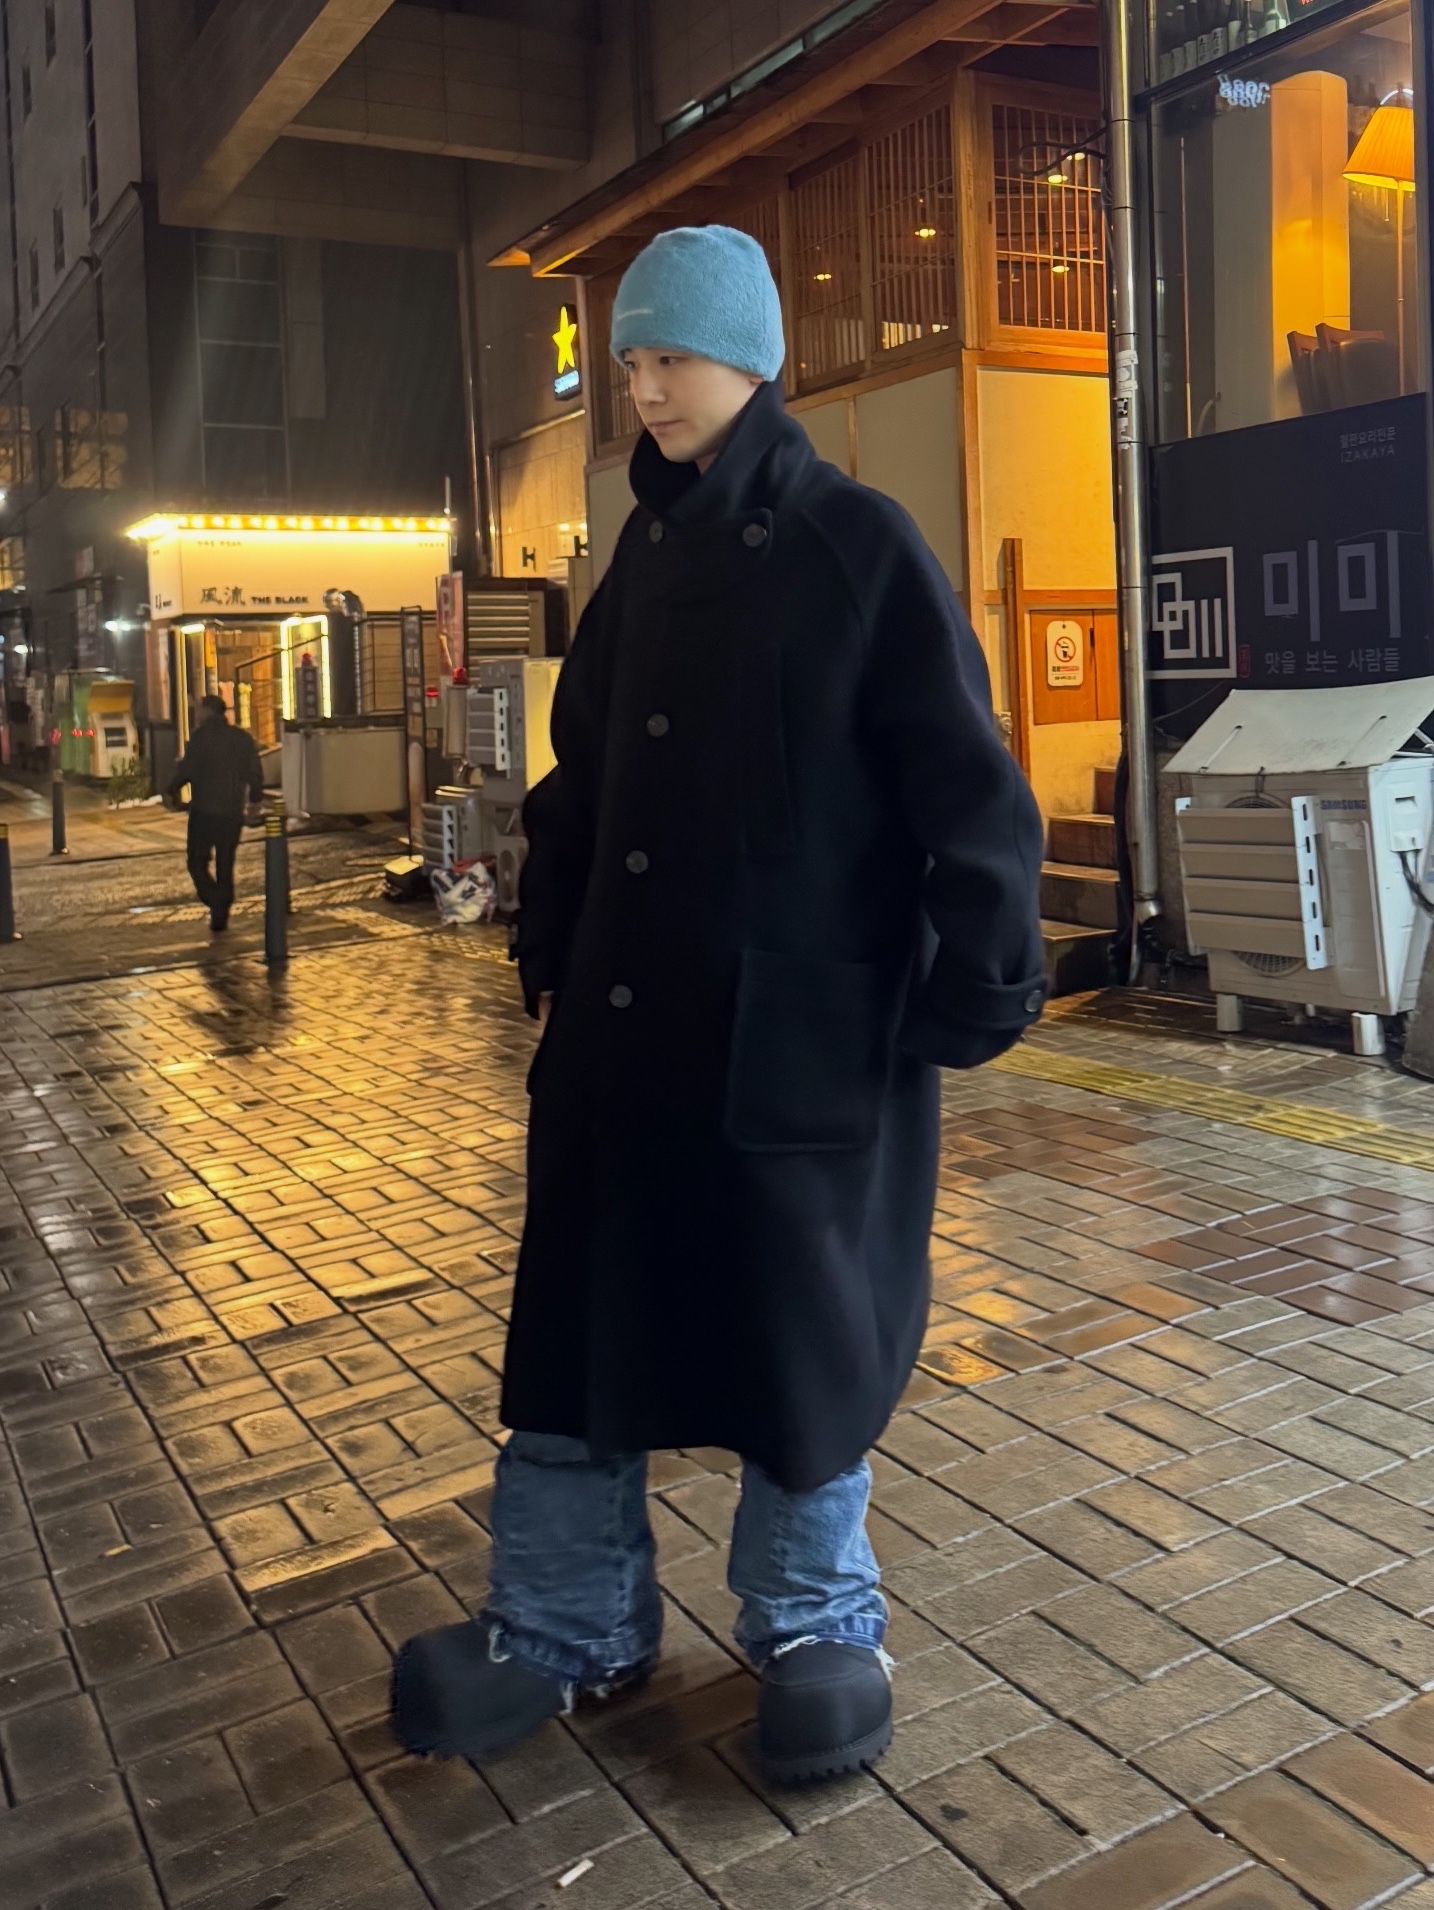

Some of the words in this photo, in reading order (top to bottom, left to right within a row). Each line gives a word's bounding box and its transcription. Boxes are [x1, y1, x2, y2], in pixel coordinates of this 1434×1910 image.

[1341, 444, 1395, 463] IZAKAYA
[1262, 530, 1402, 642] 미미
[251, 596, 271, 604] THE
[275, 596, 308, 605] BLACK
[1264, 650, 1296, 674] 맛을
[1305, 649, 1338, 673] 보는
[1347, 647, 1400, 673] 사람들
[1321, 800, 1367, 810] SAMSUNG
